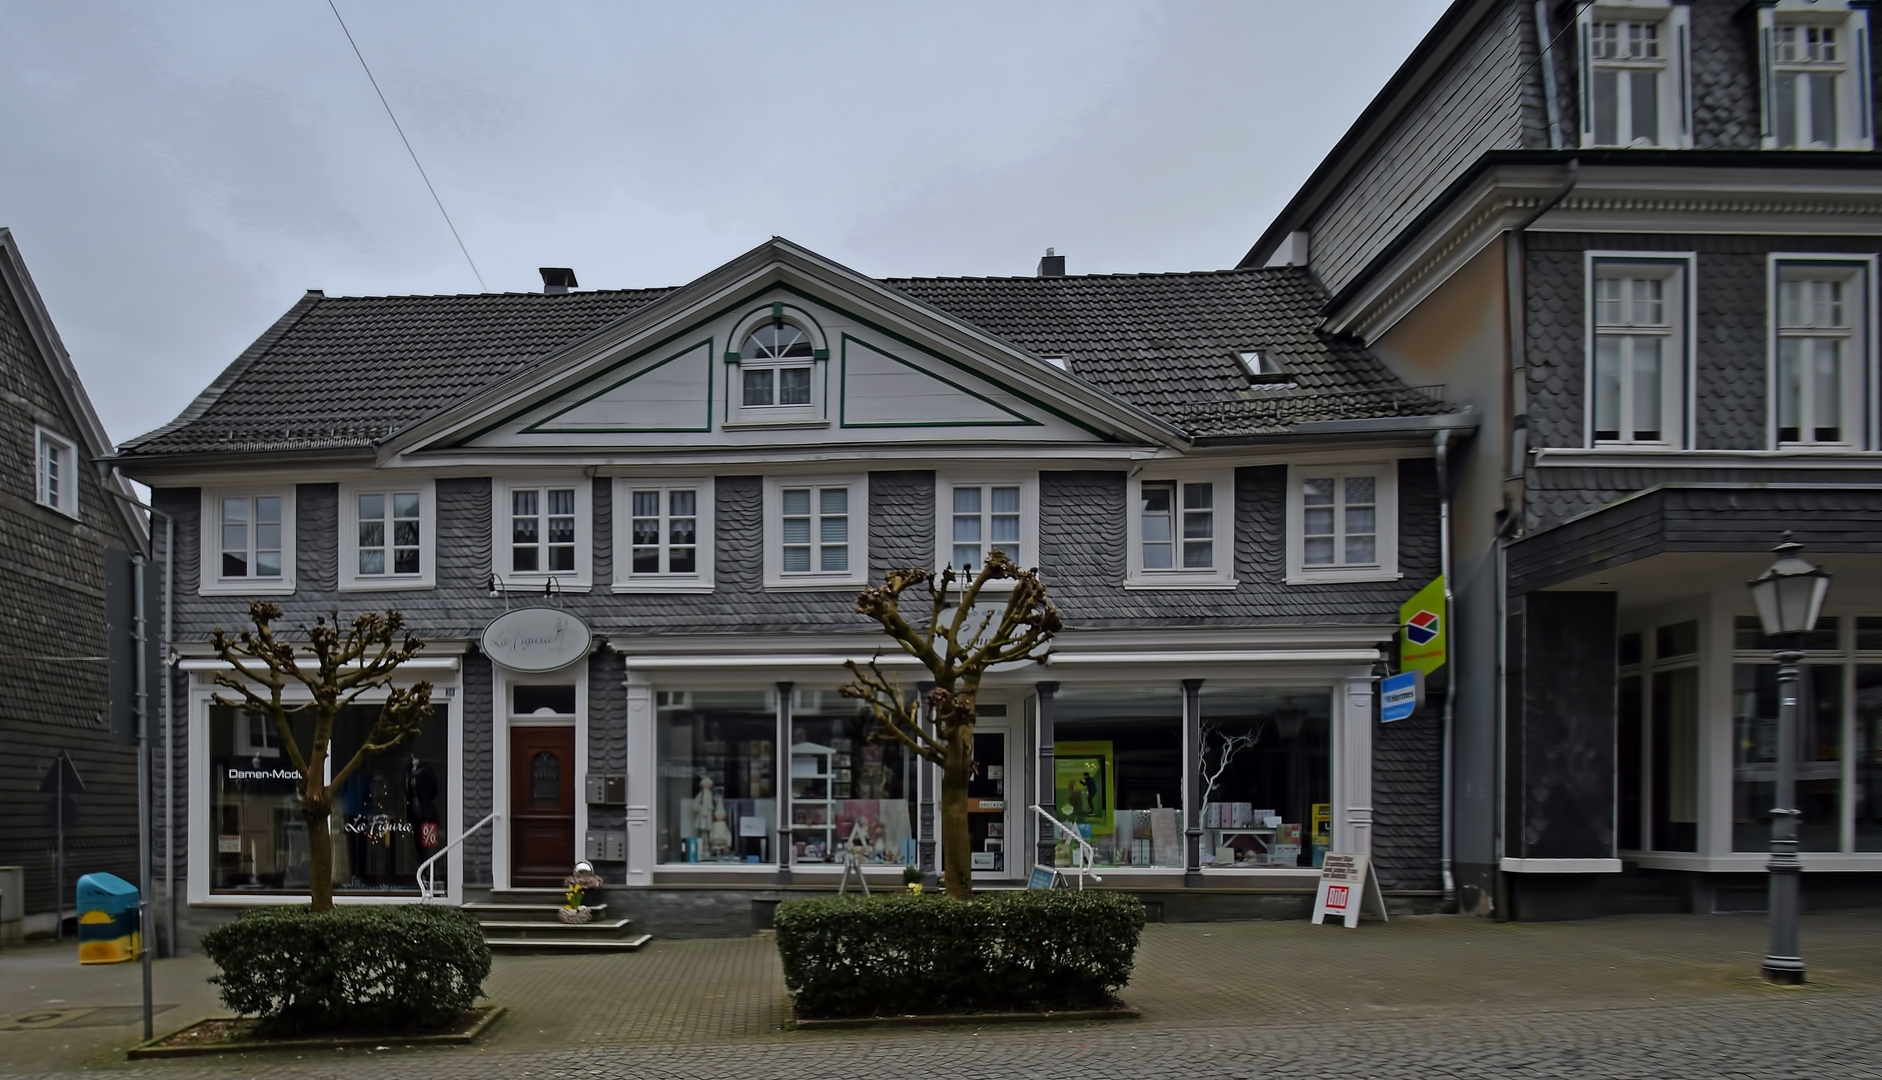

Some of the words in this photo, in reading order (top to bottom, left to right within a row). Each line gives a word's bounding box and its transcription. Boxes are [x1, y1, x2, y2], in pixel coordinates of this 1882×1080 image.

[1391, 690, 1414, 702] Hermes
[345, 813, 367, 834] La
[369, 813, 413, 838] Figura
[1327, 887, 1349, 907] Bild
